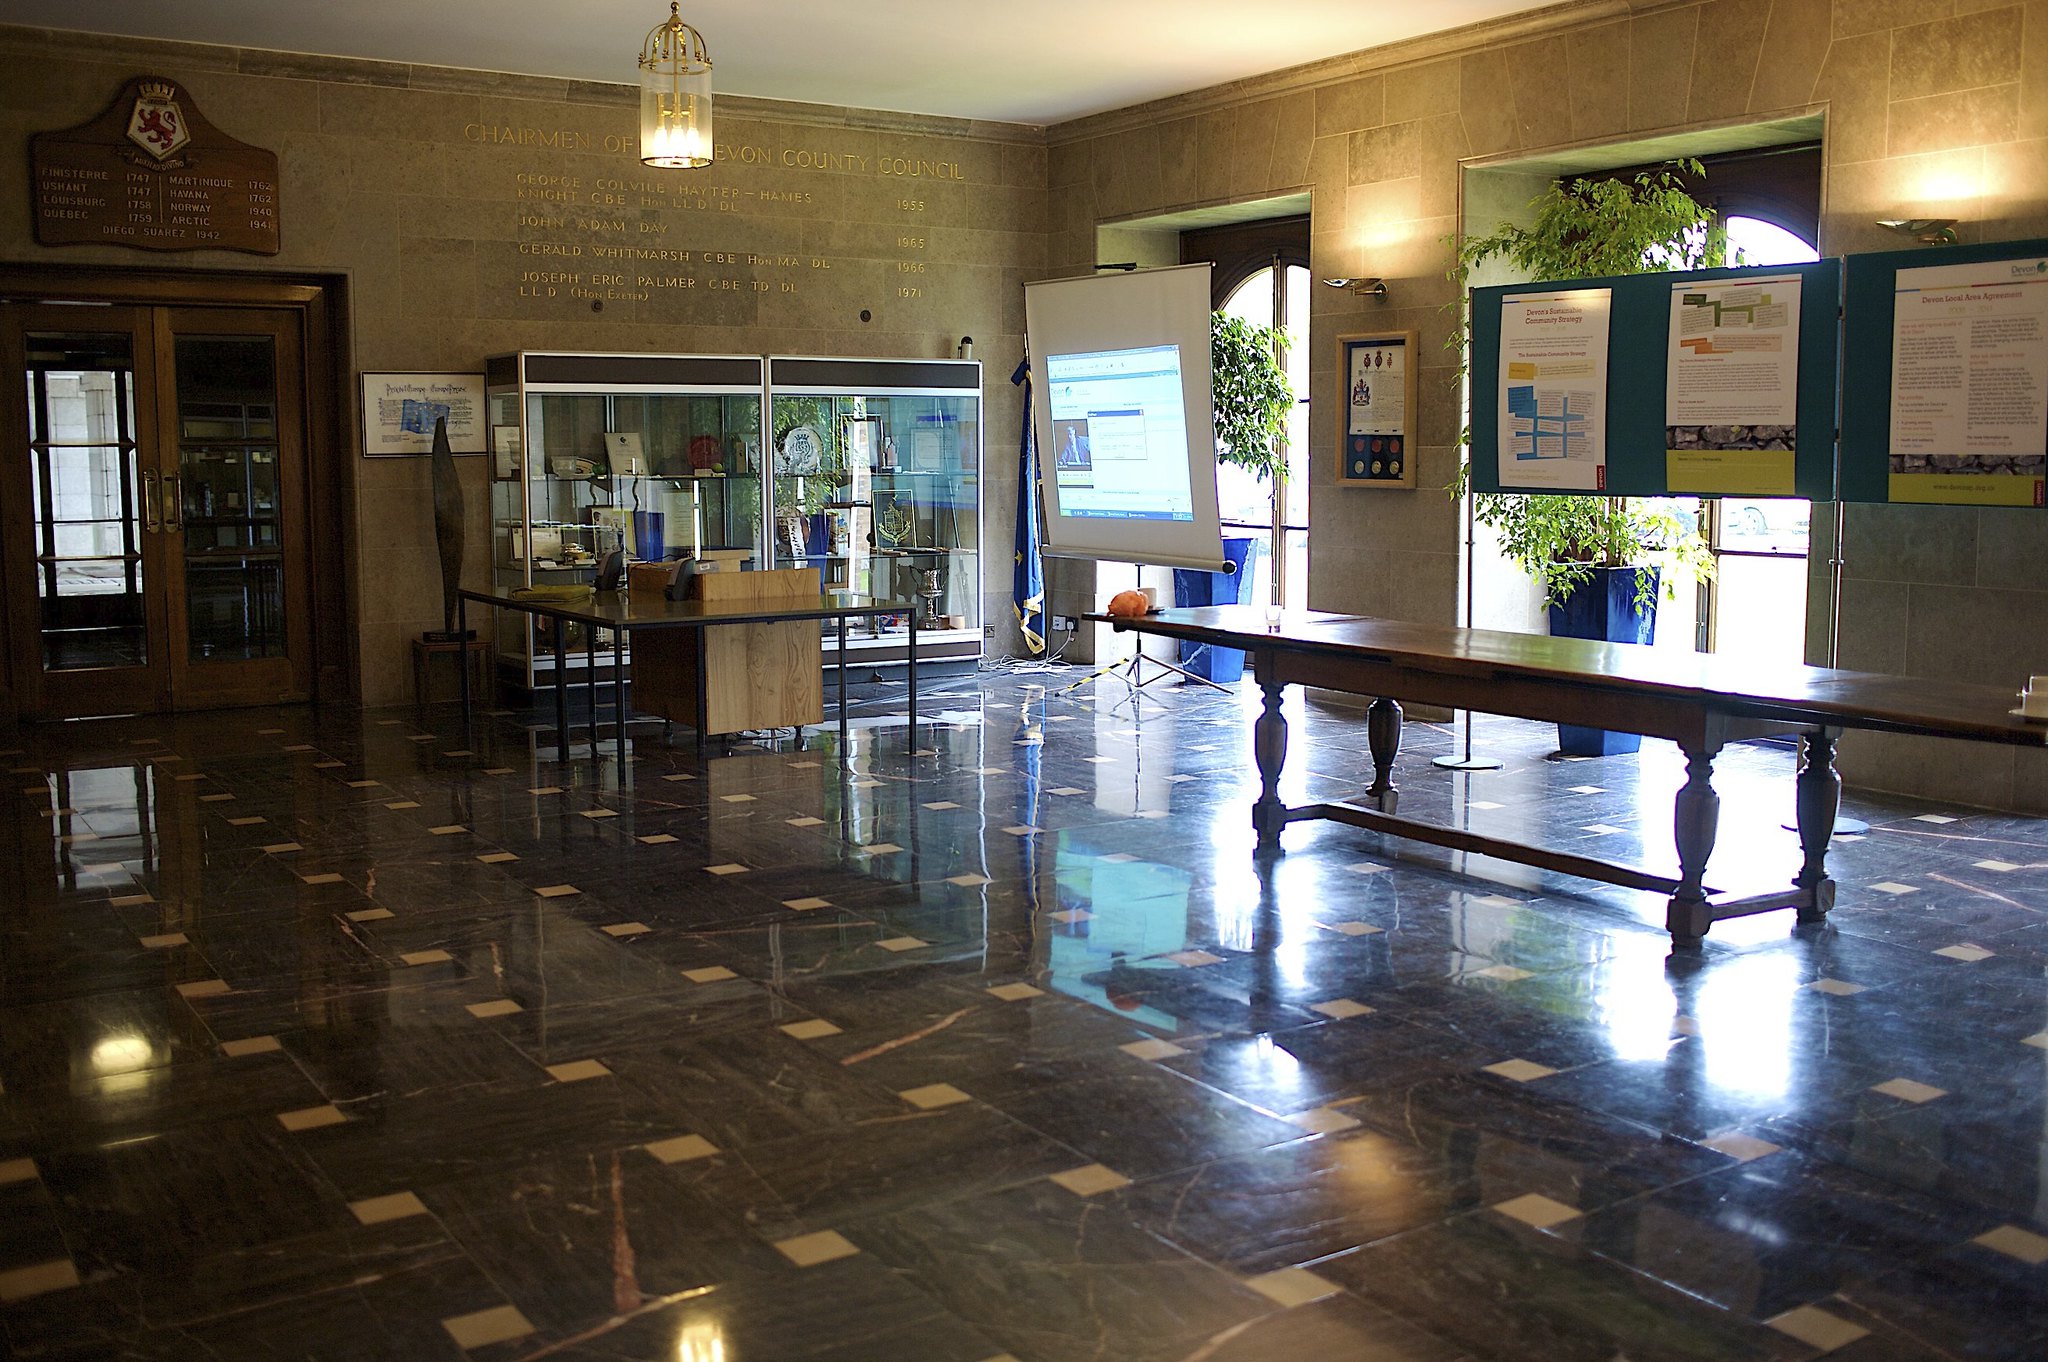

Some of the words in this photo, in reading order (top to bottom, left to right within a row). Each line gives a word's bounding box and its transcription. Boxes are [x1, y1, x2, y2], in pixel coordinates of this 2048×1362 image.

[465, 123, 590, 149] CHAIRMEN
[605, 135, 633, 153] OF
[714, 144, 771, 164] EVON
[783, 149, 870, 171] COUNTY
[879, 157, 964, 180] COUNCIL
[42, 168, 108, 180] FINISTERRE
[126, 173, 150, 183] 1747
[42, 182, 88, 193] USHANT
[127, 186, 150, 196] 1747
[169, 176, 233, 188] MARTINIQUE
[248, 181, 271, 191] 1762
[517, 173, 581, 188] GEORGE
[596, 178, 665, 194] COLVILE
[43, 195, 106, 207] LOUISBURG
[128, 200, 152, 210] 1758
[170, 189, 209, 200] HAVANA
[248, 194, 272, 204] 1762
[518, 188, 578, 201] KNIGHT
[720, 201, 740, 212] DL
[170, 202, 211, 213] NORWAY
[249, 207, 272, 217] 1940
[897, 199, 925, 212] 1955
[44, 209, 89, 220] QUEBEC
[128, 213, 152, 223] 1759
[172, 216, 210, 227] ARCTIC
[519, 215, 565, 229] JOHN
[578, 219, 625, 233] ADAM
[639, 222, 669, 234] DAY
[103, 225, 135, 236] DIEGO
[143, 227, 185, 238] SUAREZ
[196, 230, 220, 240] 1942
[897, 237, 925, 249] 1965
[519, 243, 581, 257] GERALD
[592, 246, 689, 262] WHITMARSH
[778, 256, 801, 267] MA
[812, 258, 831, 269] DL
[898, 262, 925, 273] 1966
[2011, 265, 2036, 275] Devon
[521, 271, 579, 284] JOSEPH
[592, 274, 625, 287] ERIC
[638, 276, 696, 290] PALMER
[751, 281, 769, 292] TD
[781, 282, 799, 294] DL
[898, 287, 922, 298] 1971
[1922, 296, 1944, 304] Devon
[1945, 294, 1964, 302] Local
[1964, 293, 1981, 301] Area
[1982, 291, 2023, 301] Agreement
[1526, 308, 1548, 316] Devon's
[1549, 306, 1583, 315] Sustainable
[1525, 316, 1557, 326] Community
[1558, 315, 1583, 324] Strategy
